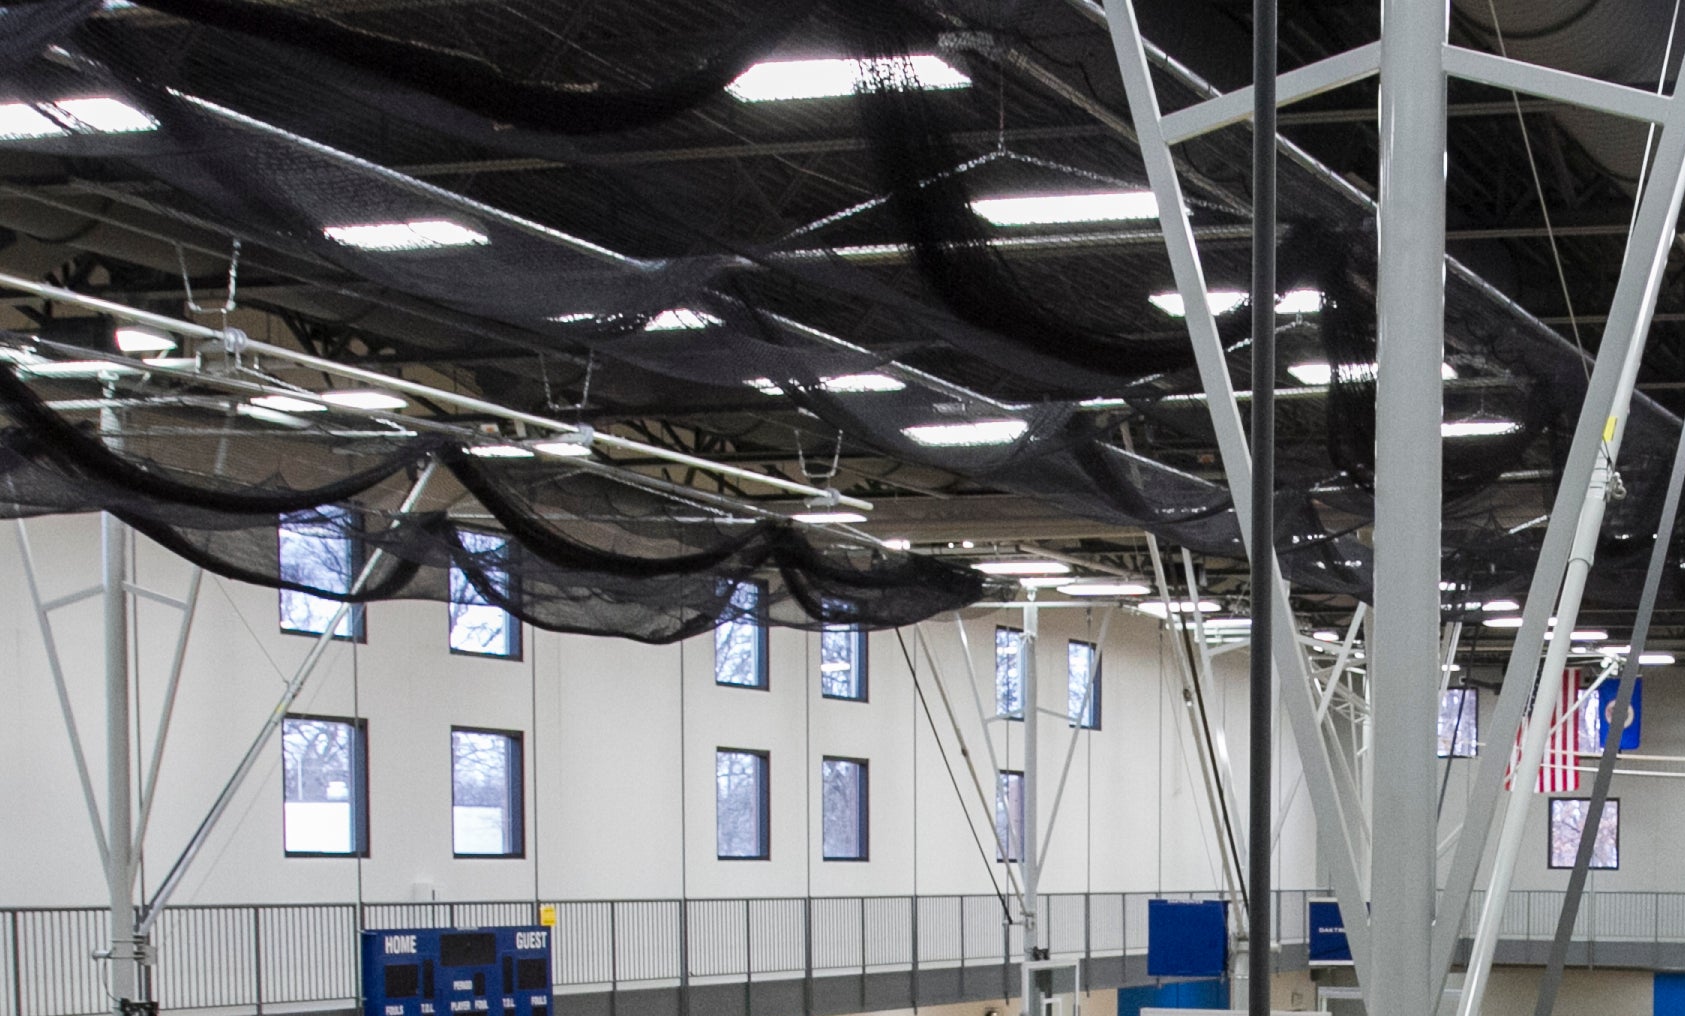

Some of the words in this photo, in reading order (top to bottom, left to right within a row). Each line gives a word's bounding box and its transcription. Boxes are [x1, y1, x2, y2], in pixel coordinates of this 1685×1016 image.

[385, 935, 417, 954] HOME
[516, 932, 547, 949] GUEST
[453, 980, 473, 991] PERIOD
[450, 1001, 471, 1011] PLAYER
[474, 1000, 489, 1010] FOUL
[531, 996, 547, 1006] FOULS
[386, 1005, 404, 1016] FOULS
